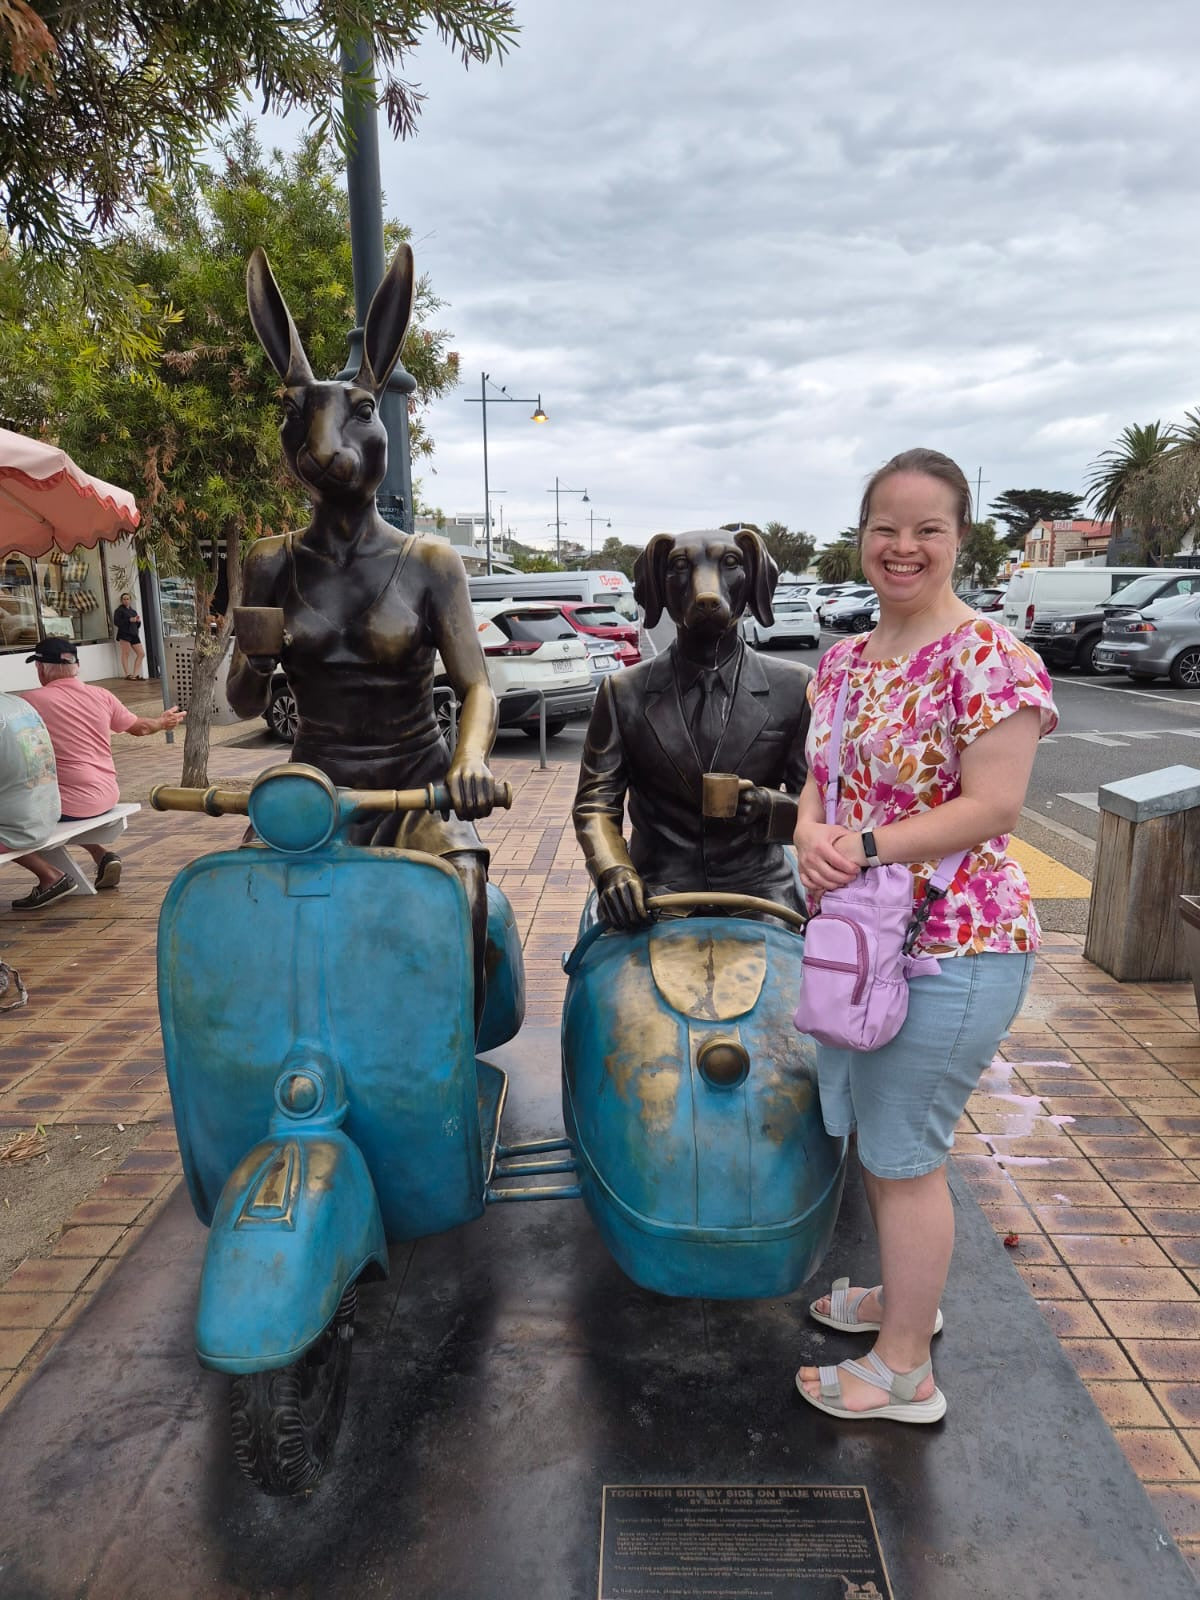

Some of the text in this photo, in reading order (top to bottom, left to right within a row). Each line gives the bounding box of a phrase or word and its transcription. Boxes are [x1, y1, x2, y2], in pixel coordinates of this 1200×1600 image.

[611, 1489, 861, 1498] TOGETHER SIDE BY SIDE ON BLUE WHEELS
